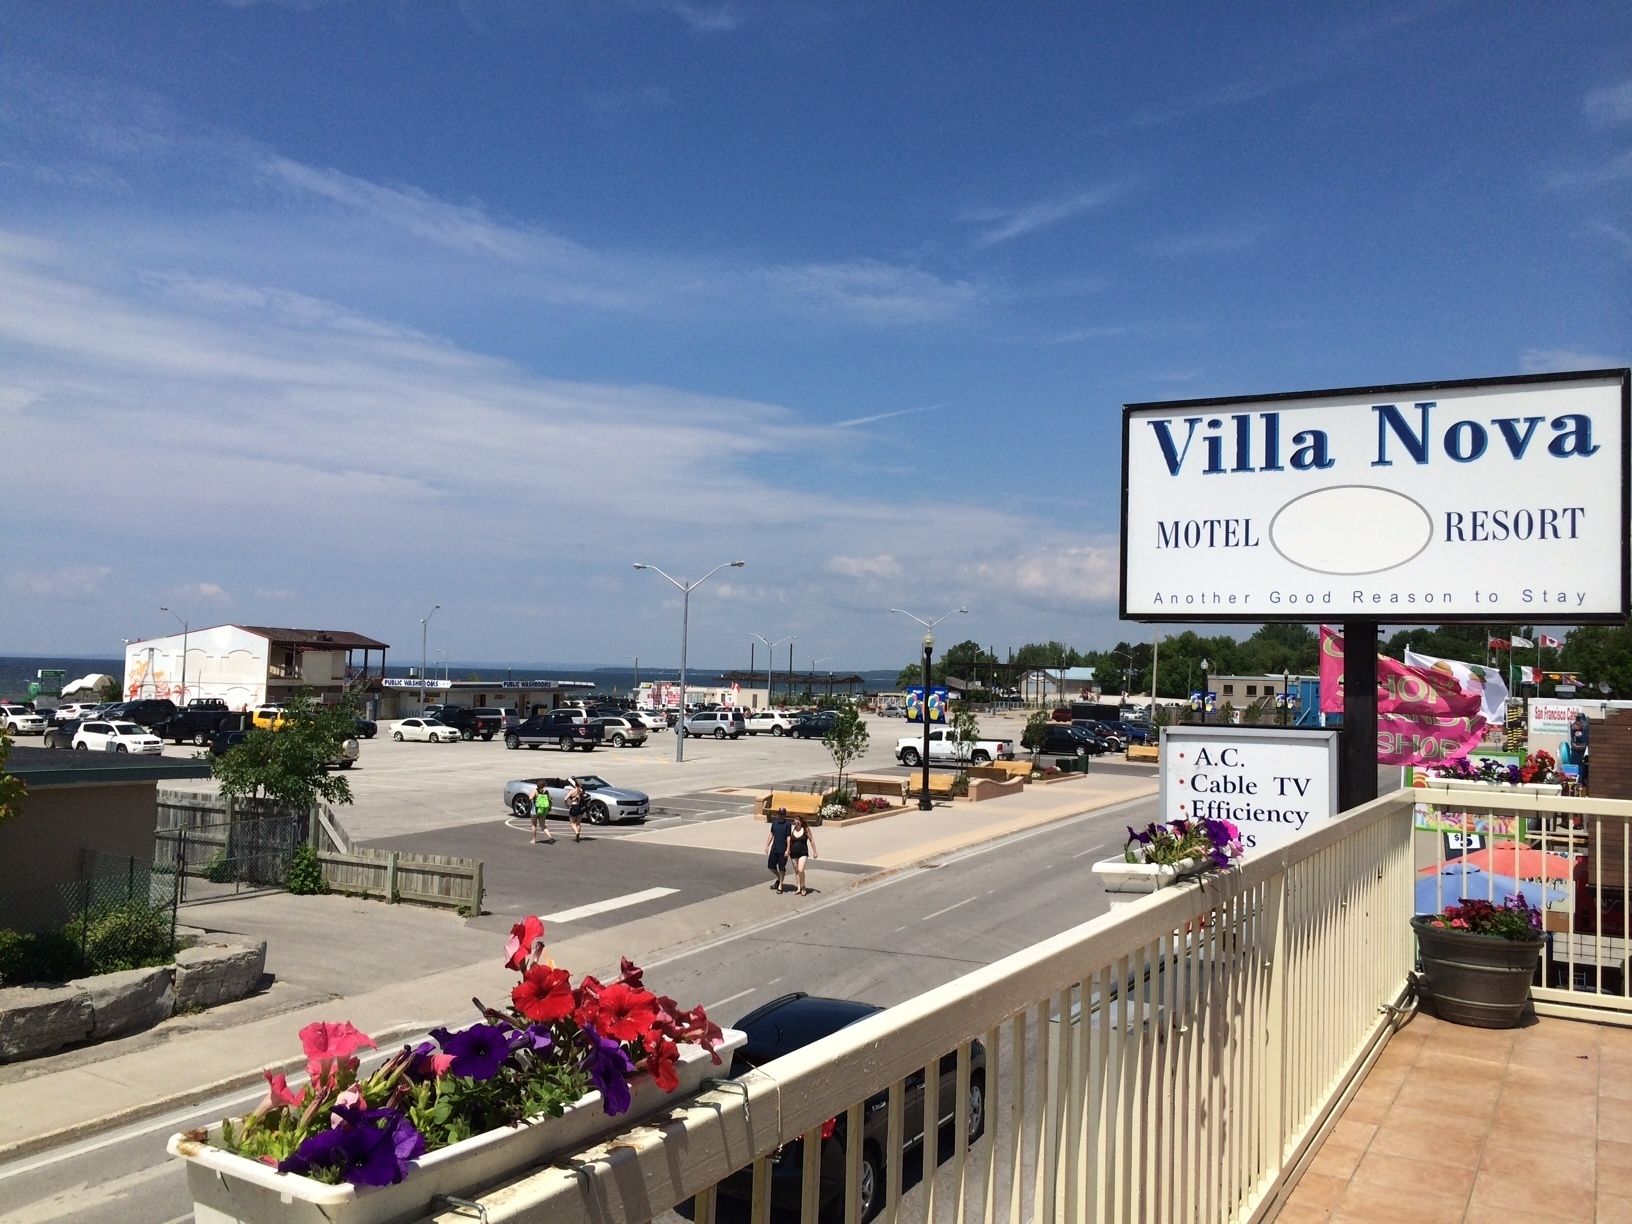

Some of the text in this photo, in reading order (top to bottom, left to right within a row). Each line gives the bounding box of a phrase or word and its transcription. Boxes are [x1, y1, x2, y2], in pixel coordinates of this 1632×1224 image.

[1147, 401, 1601, 477] Villa Nova
[1156, 507, 1585, 549] MOTEL RESORT
[1153, 589, 1586, 606] Another Good Reason to Stay
[1194, 747, 1245, 768] A.C.
[1190, 773, 1312, 797] Cable TV
[1191, 799, 1310, 831] Efficiency
